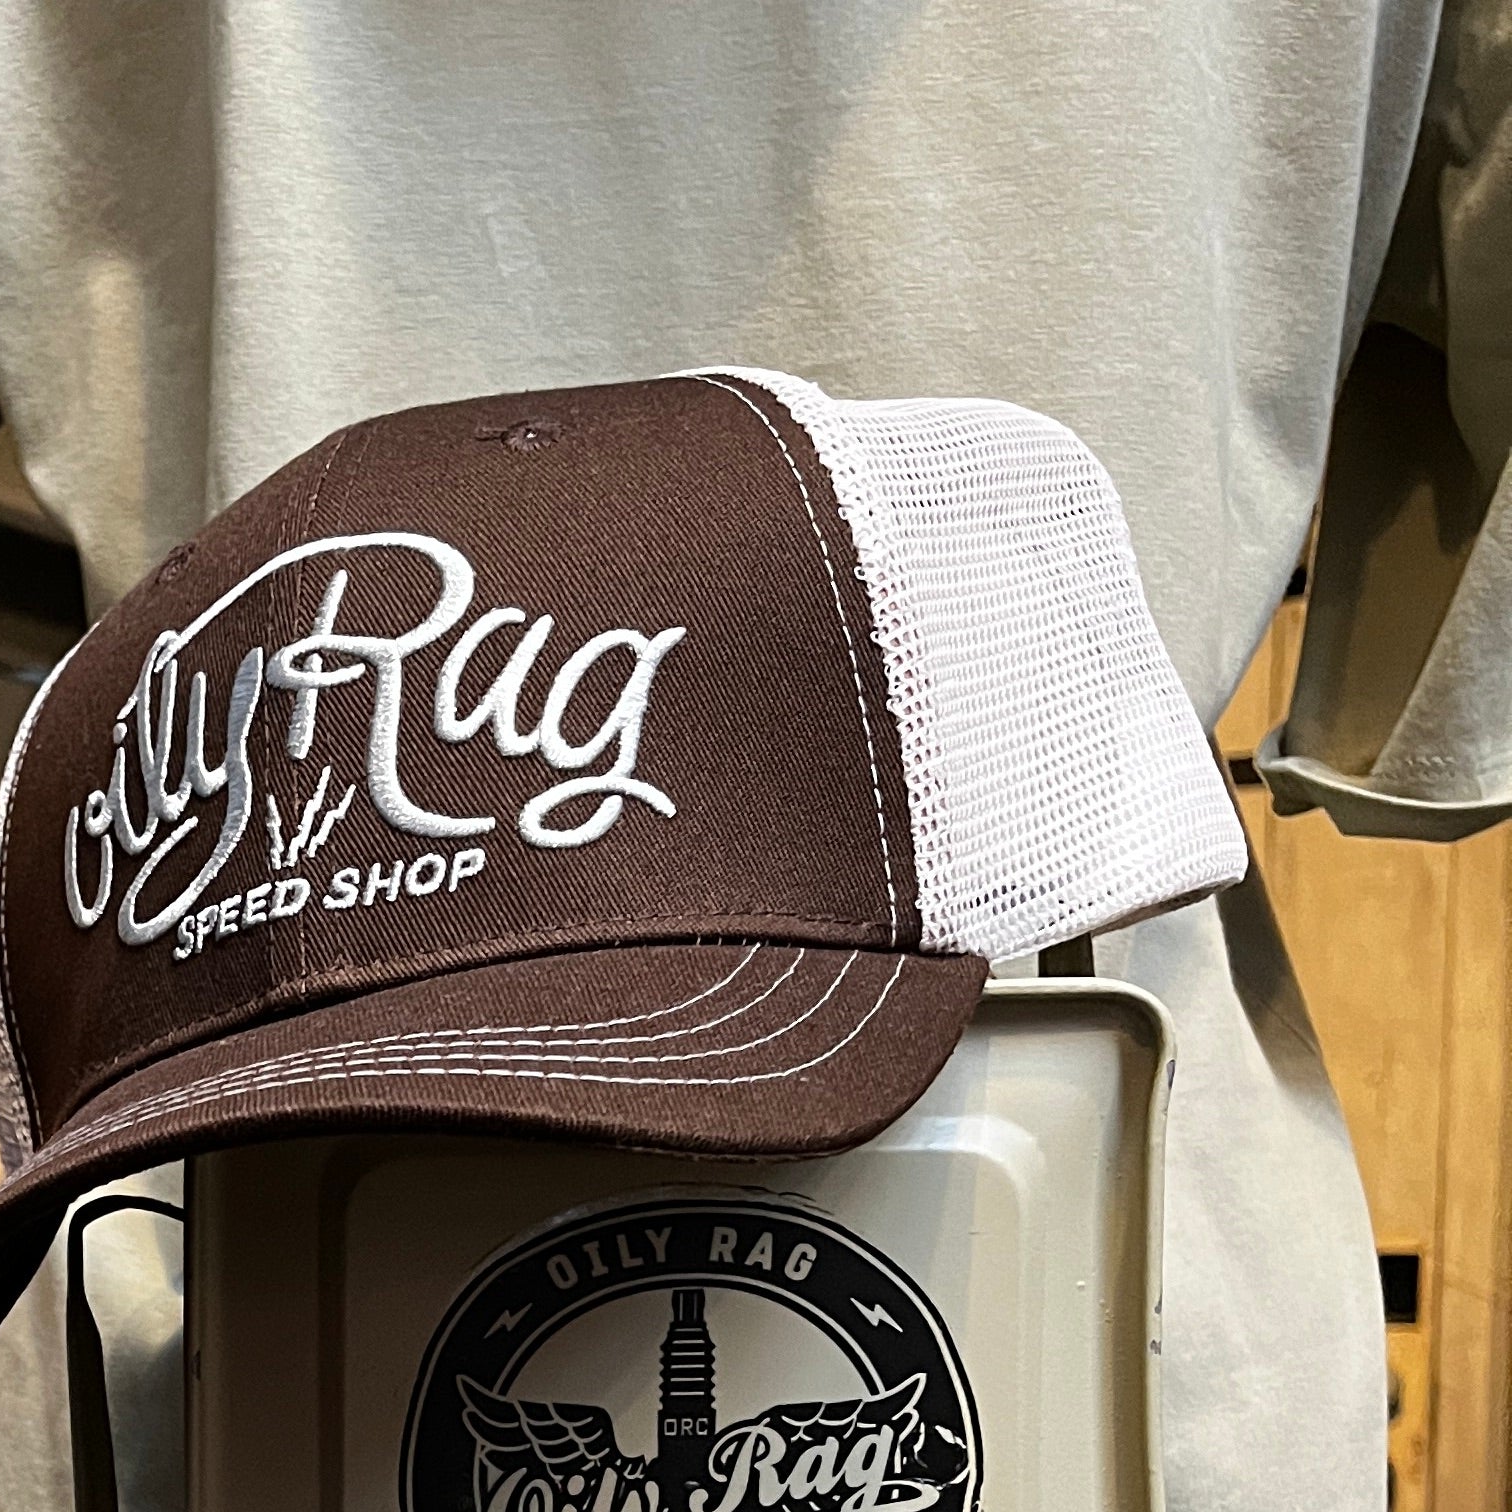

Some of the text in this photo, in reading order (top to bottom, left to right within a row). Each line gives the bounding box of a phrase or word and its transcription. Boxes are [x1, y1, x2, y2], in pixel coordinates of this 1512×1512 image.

[158, 531, 688, 849] Rag
[174, 847, 487, 961] SPEED SHOP
[546, 1226, 818, 1290] OILY RAG
[663, 1417, 710, 1437] ORC
